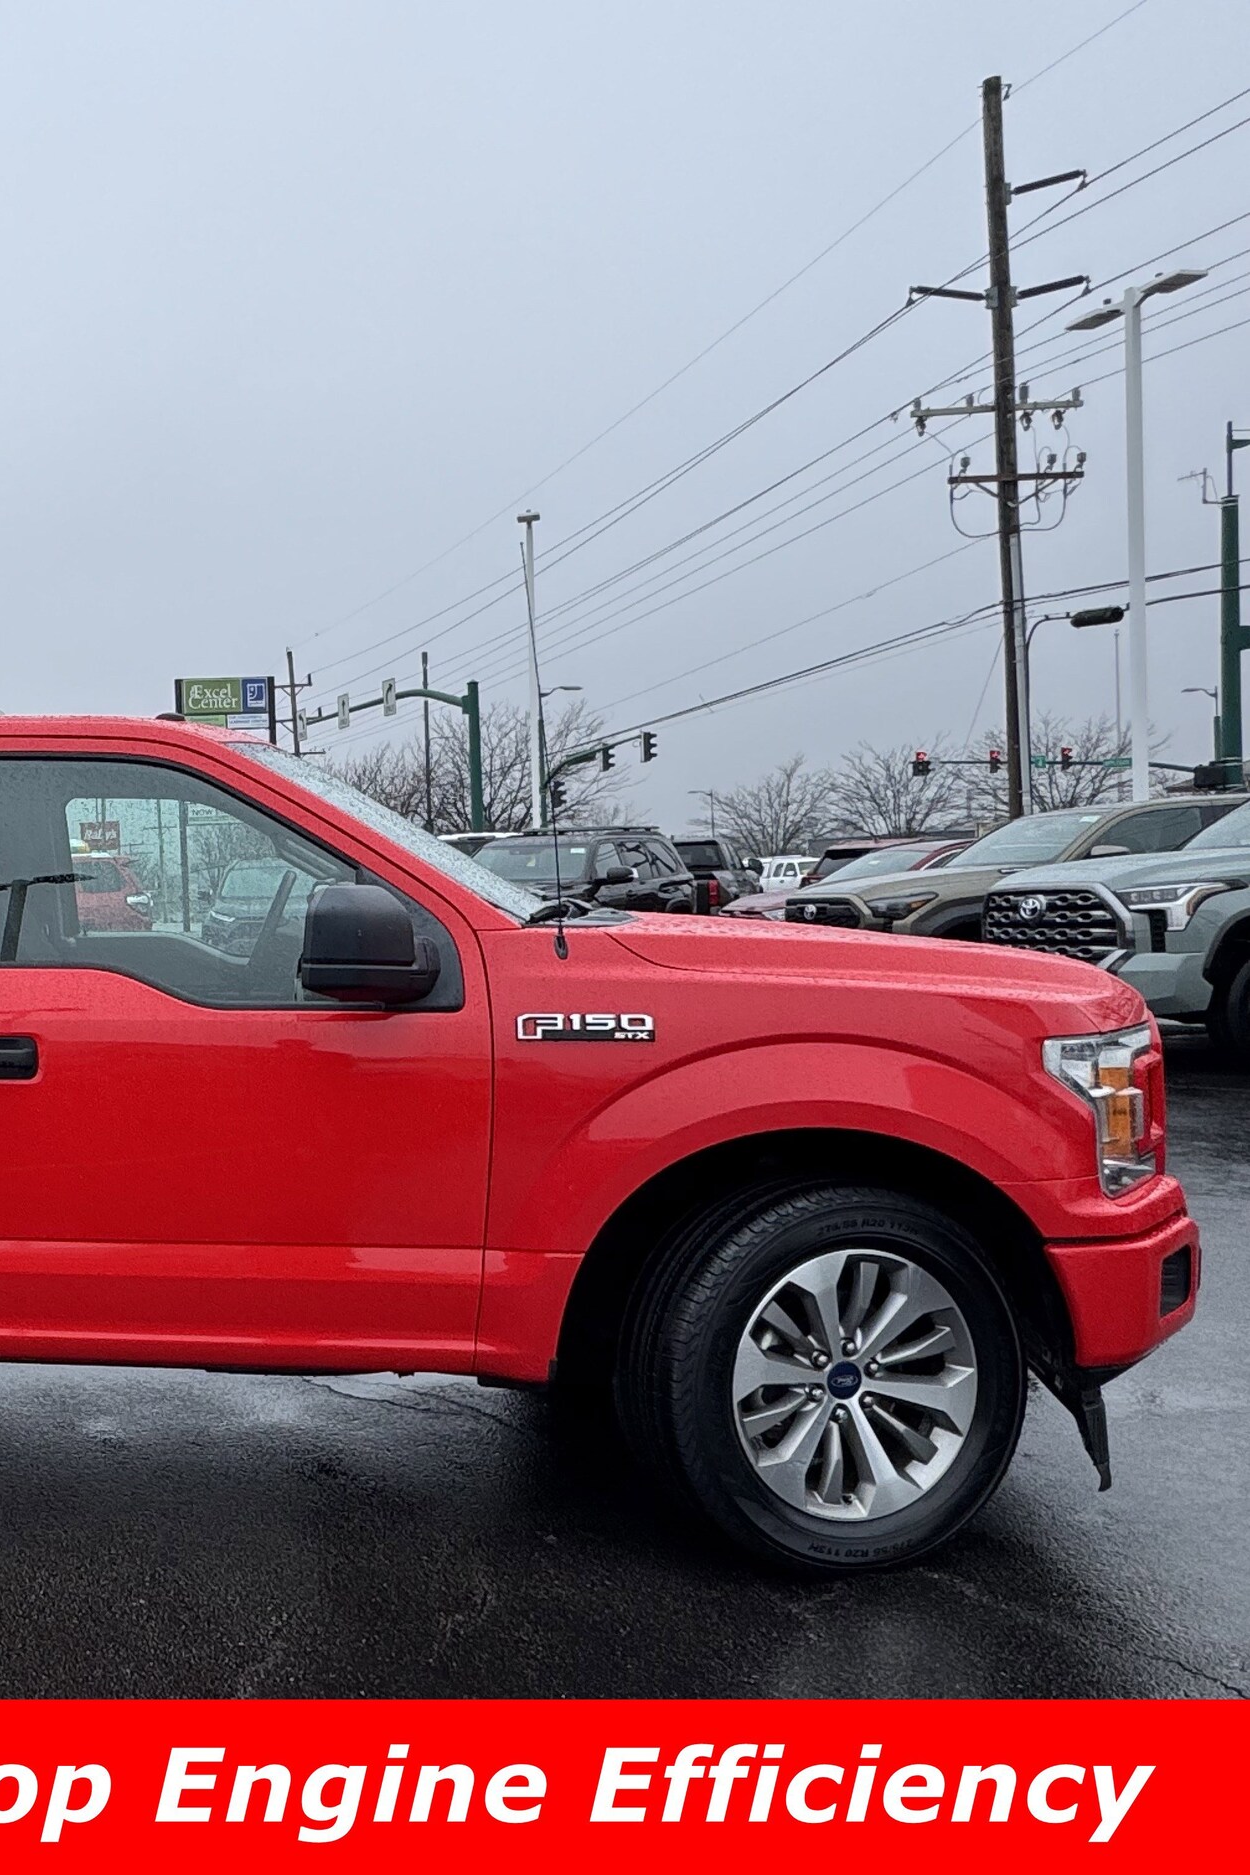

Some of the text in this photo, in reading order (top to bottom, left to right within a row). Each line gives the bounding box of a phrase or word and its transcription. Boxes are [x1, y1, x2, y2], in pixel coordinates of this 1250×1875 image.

[188, 696, 238, 709] Center
[83, 829, 117, 841] Raly's
[614, 1031, 650, 1040] STX
